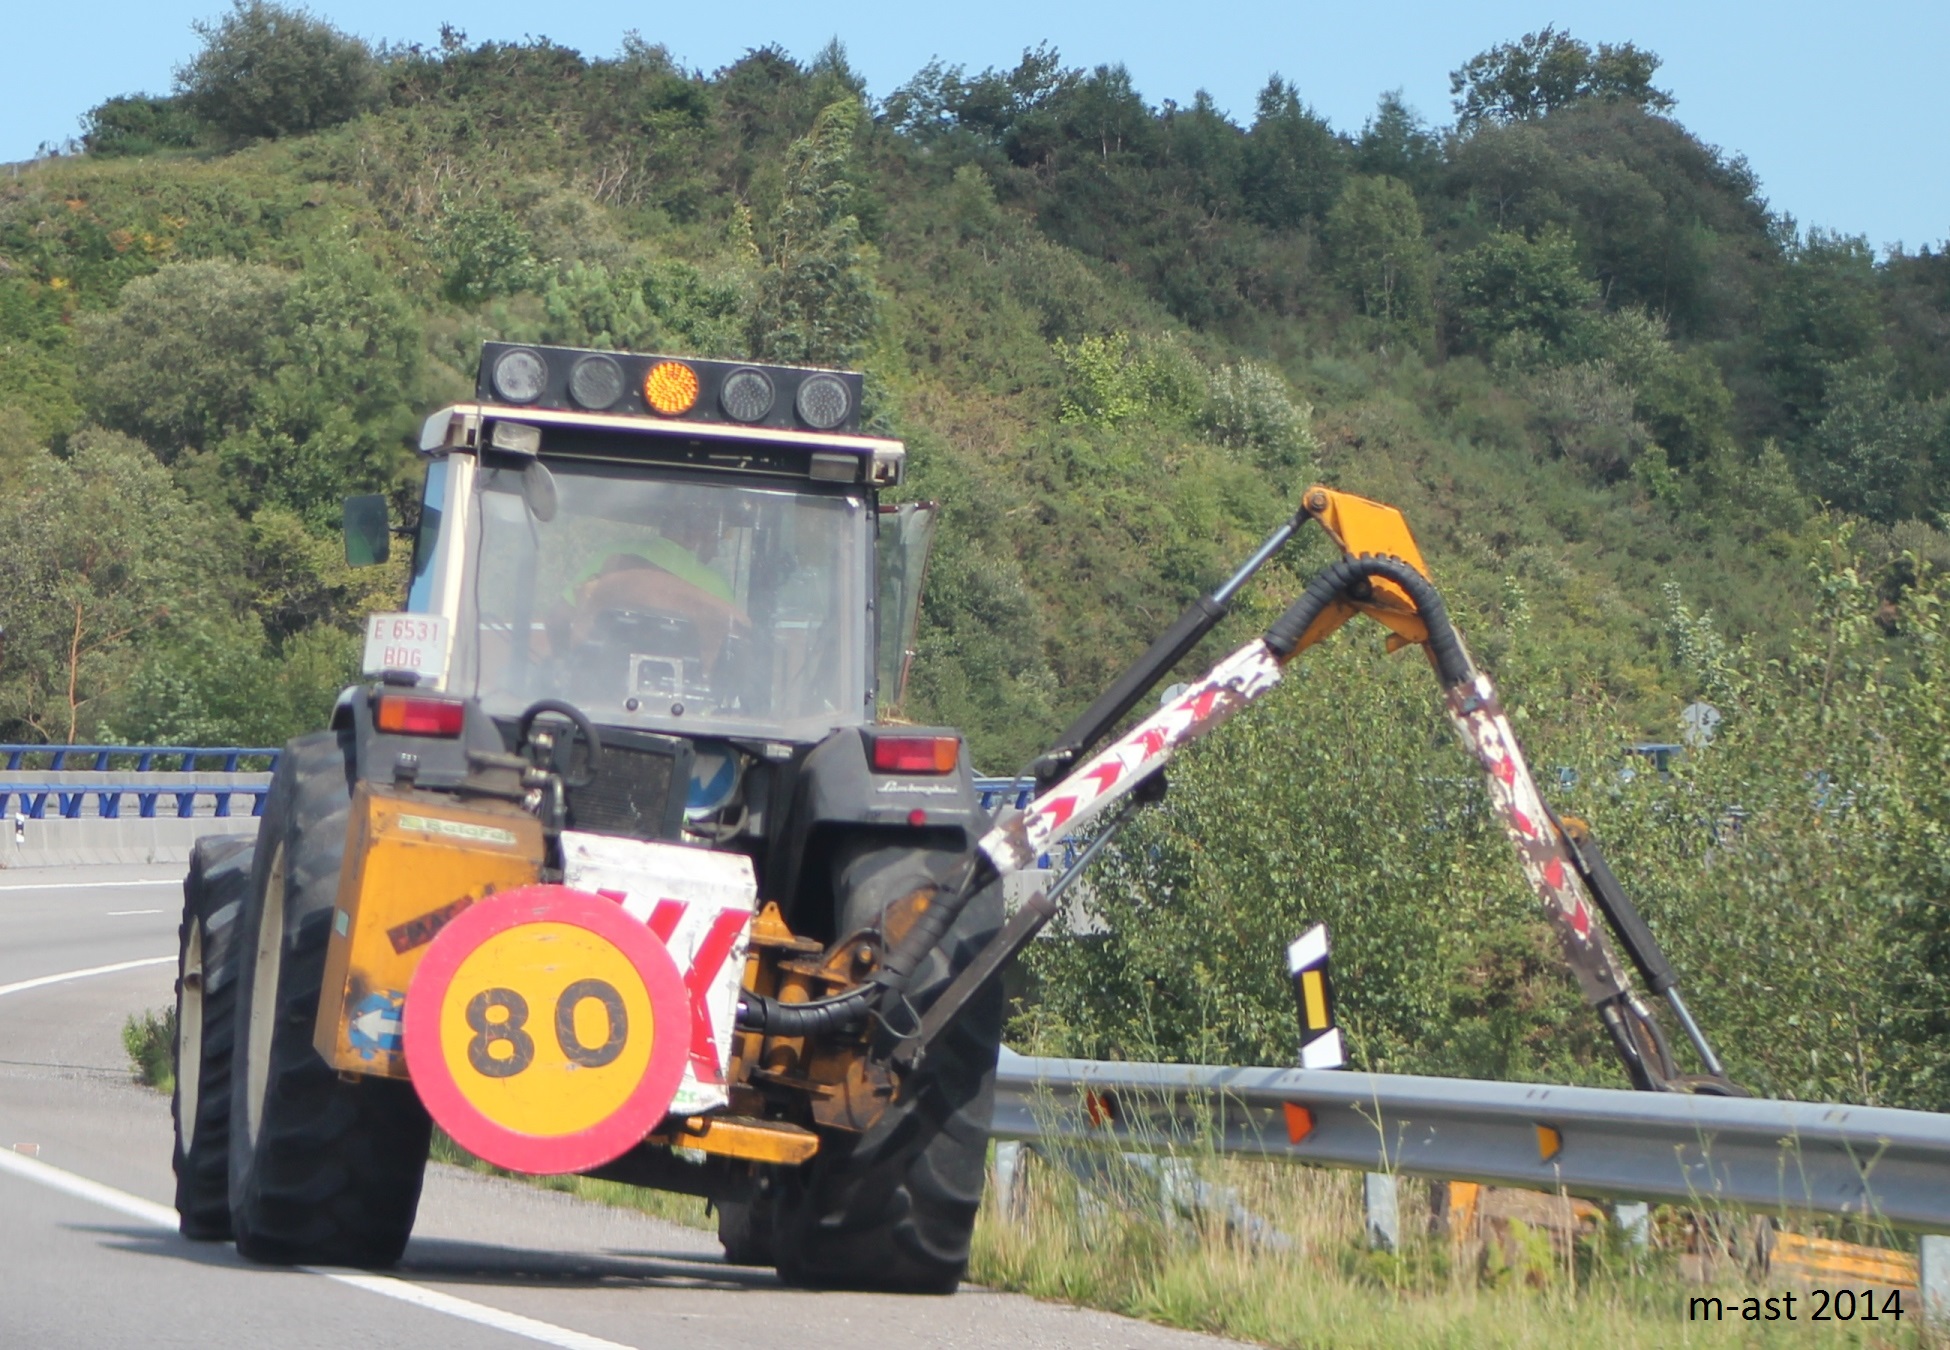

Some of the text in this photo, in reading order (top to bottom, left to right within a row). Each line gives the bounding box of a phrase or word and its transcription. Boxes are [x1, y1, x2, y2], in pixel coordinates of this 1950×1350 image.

[374, 619, 438, 641] E 6531
[384, 646, 422, 667] BDG
[465, 977, 629, 1079] 80
